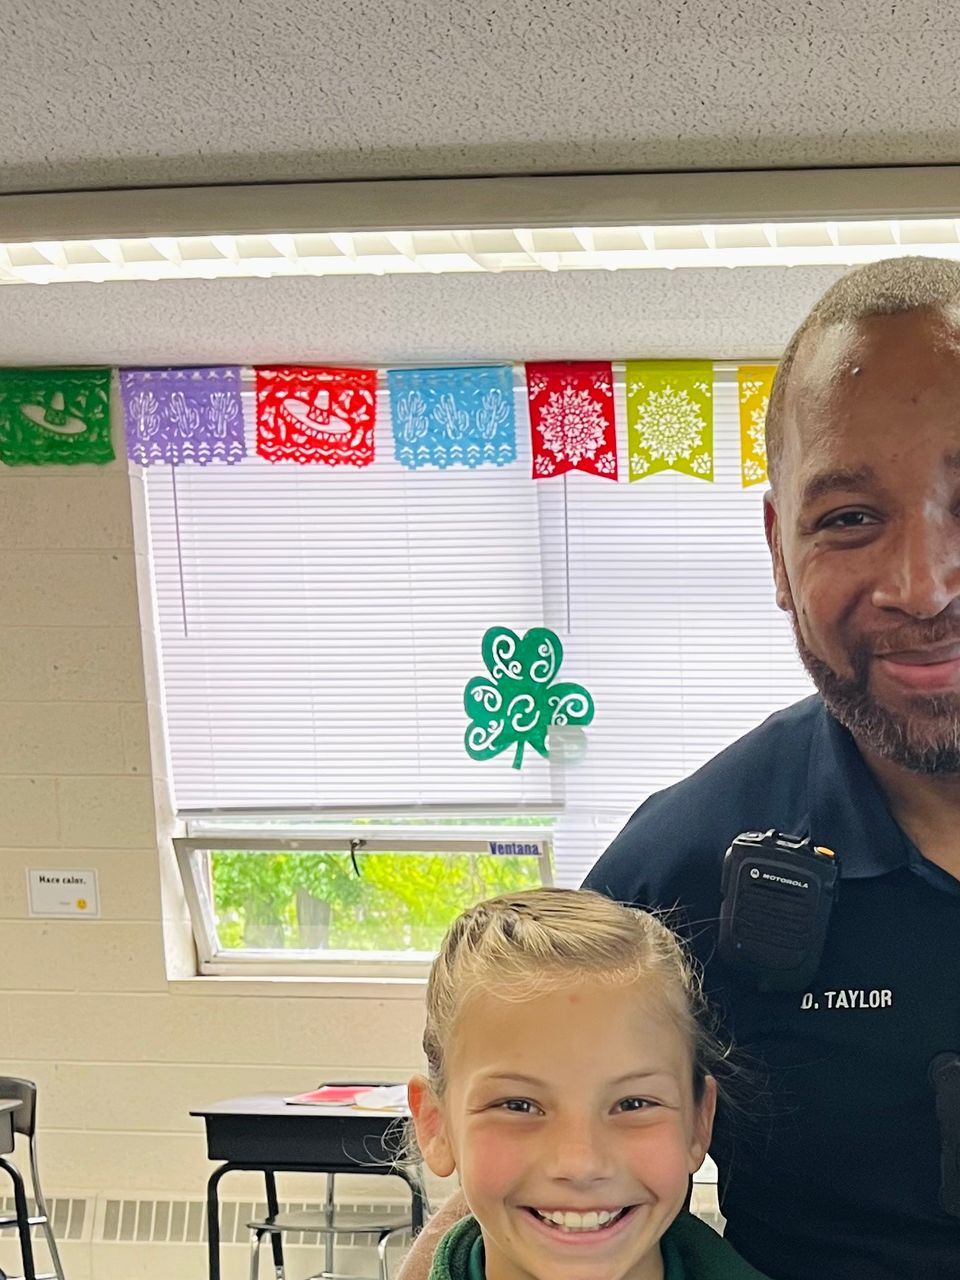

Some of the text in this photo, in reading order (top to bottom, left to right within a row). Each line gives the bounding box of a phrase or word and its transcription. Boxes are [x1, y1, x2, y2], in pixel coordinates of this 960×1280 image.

[489, 841, 540, 856] Ventana
[762, 873, 809, 889] MOTOROLA
[800, 989, 892, 1010] D. TAYLOR
